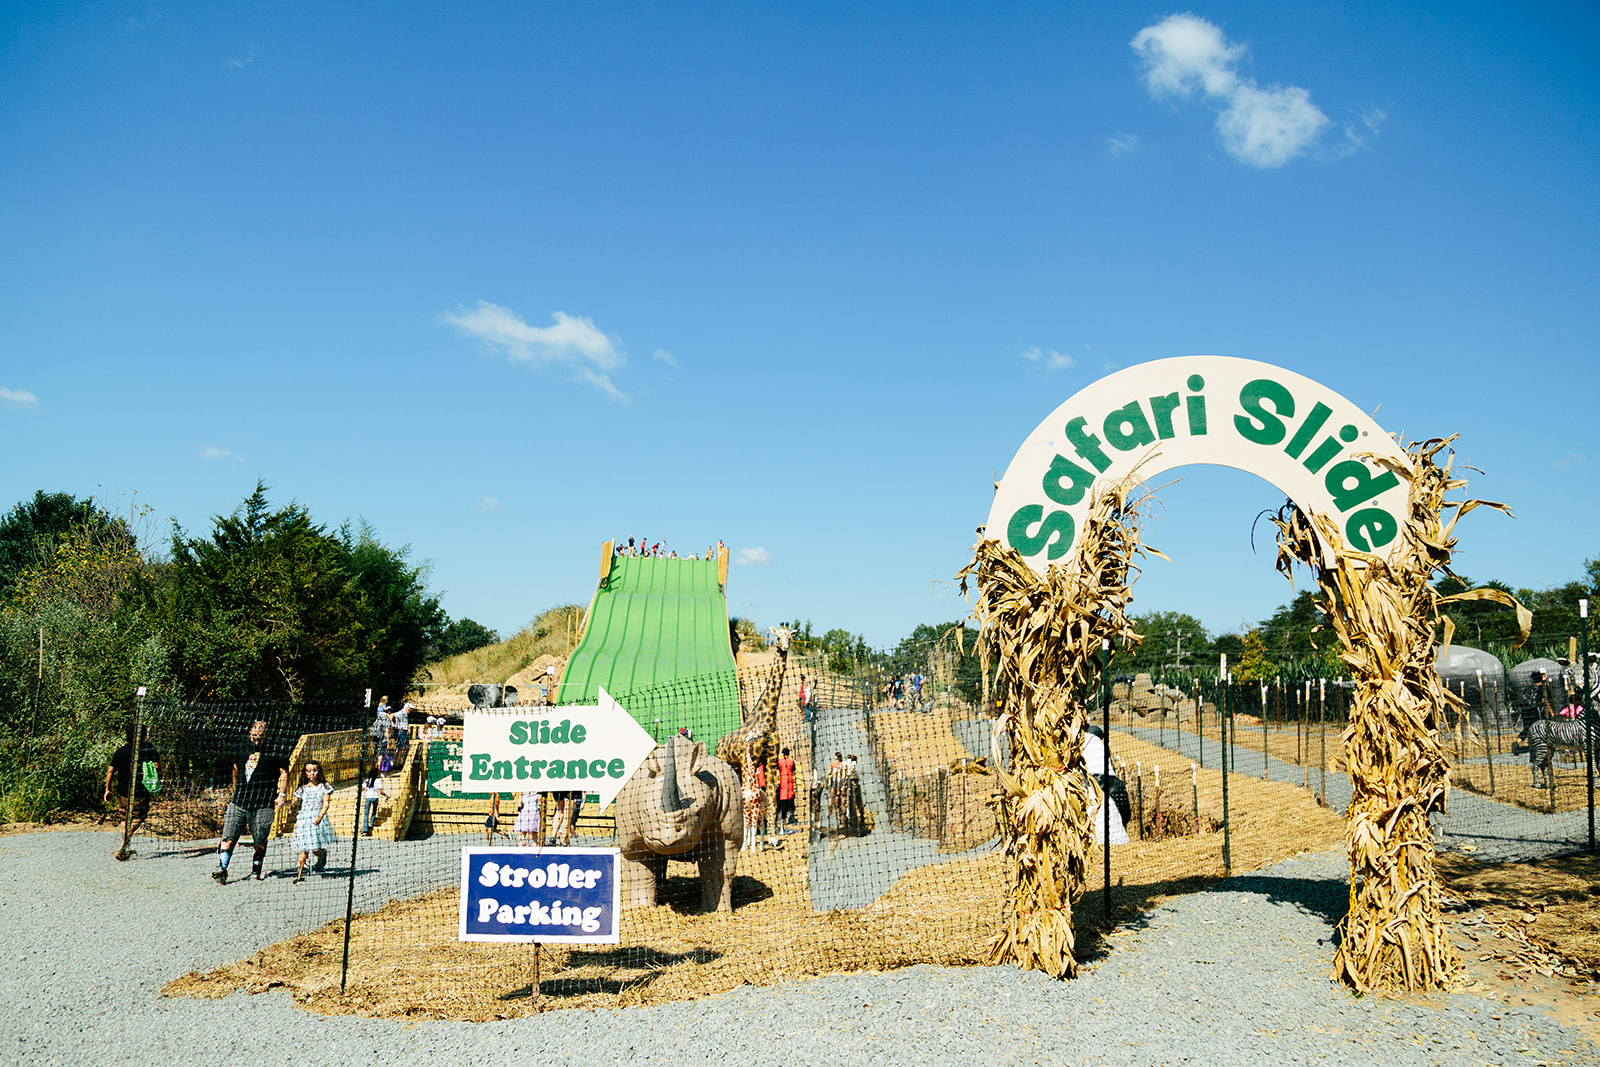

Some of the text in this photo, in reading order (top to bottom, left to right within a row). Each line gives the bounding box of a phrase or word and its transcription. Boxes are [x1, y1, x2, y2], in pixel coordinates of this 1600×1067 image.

[1007, 374, 1400, 560] Safari Slide
[509, 719, 587, 745] Slide
[469, 753, 625, 781] Entrance
[478, 861, 602, 889] Stroller
[477, 898, 602, 933] Parking
